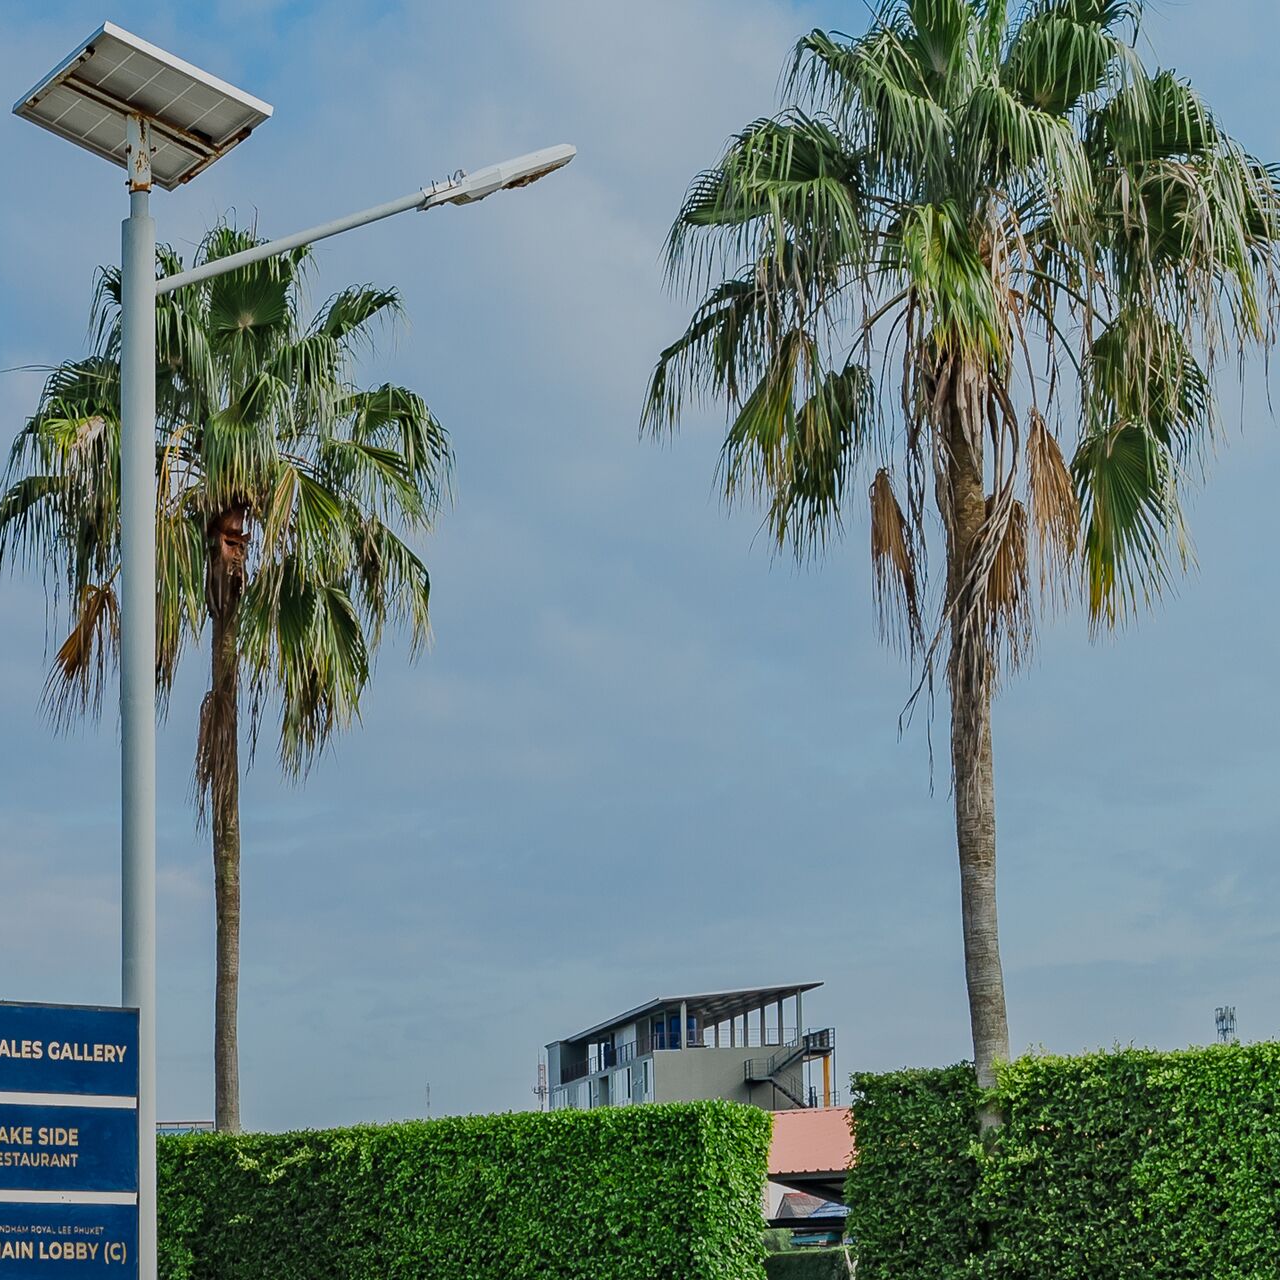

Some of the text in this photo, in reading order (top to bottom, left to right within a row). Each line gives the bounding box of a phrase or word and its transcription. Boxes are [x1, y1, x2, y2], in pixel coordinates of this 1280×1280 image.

[47, 1042, 127, 1063] GALLERY
[38, 1127, 79, 1146] SIDE
[31, 1225, 56, 1234] ROYAL
[58, 1226, 71, 1235] LEE
[74, 1226, 104, 1235] PHUKET
[39, 1241, 99, 1260] LOBBY
[104, 1241, 127, 1265] (C)
